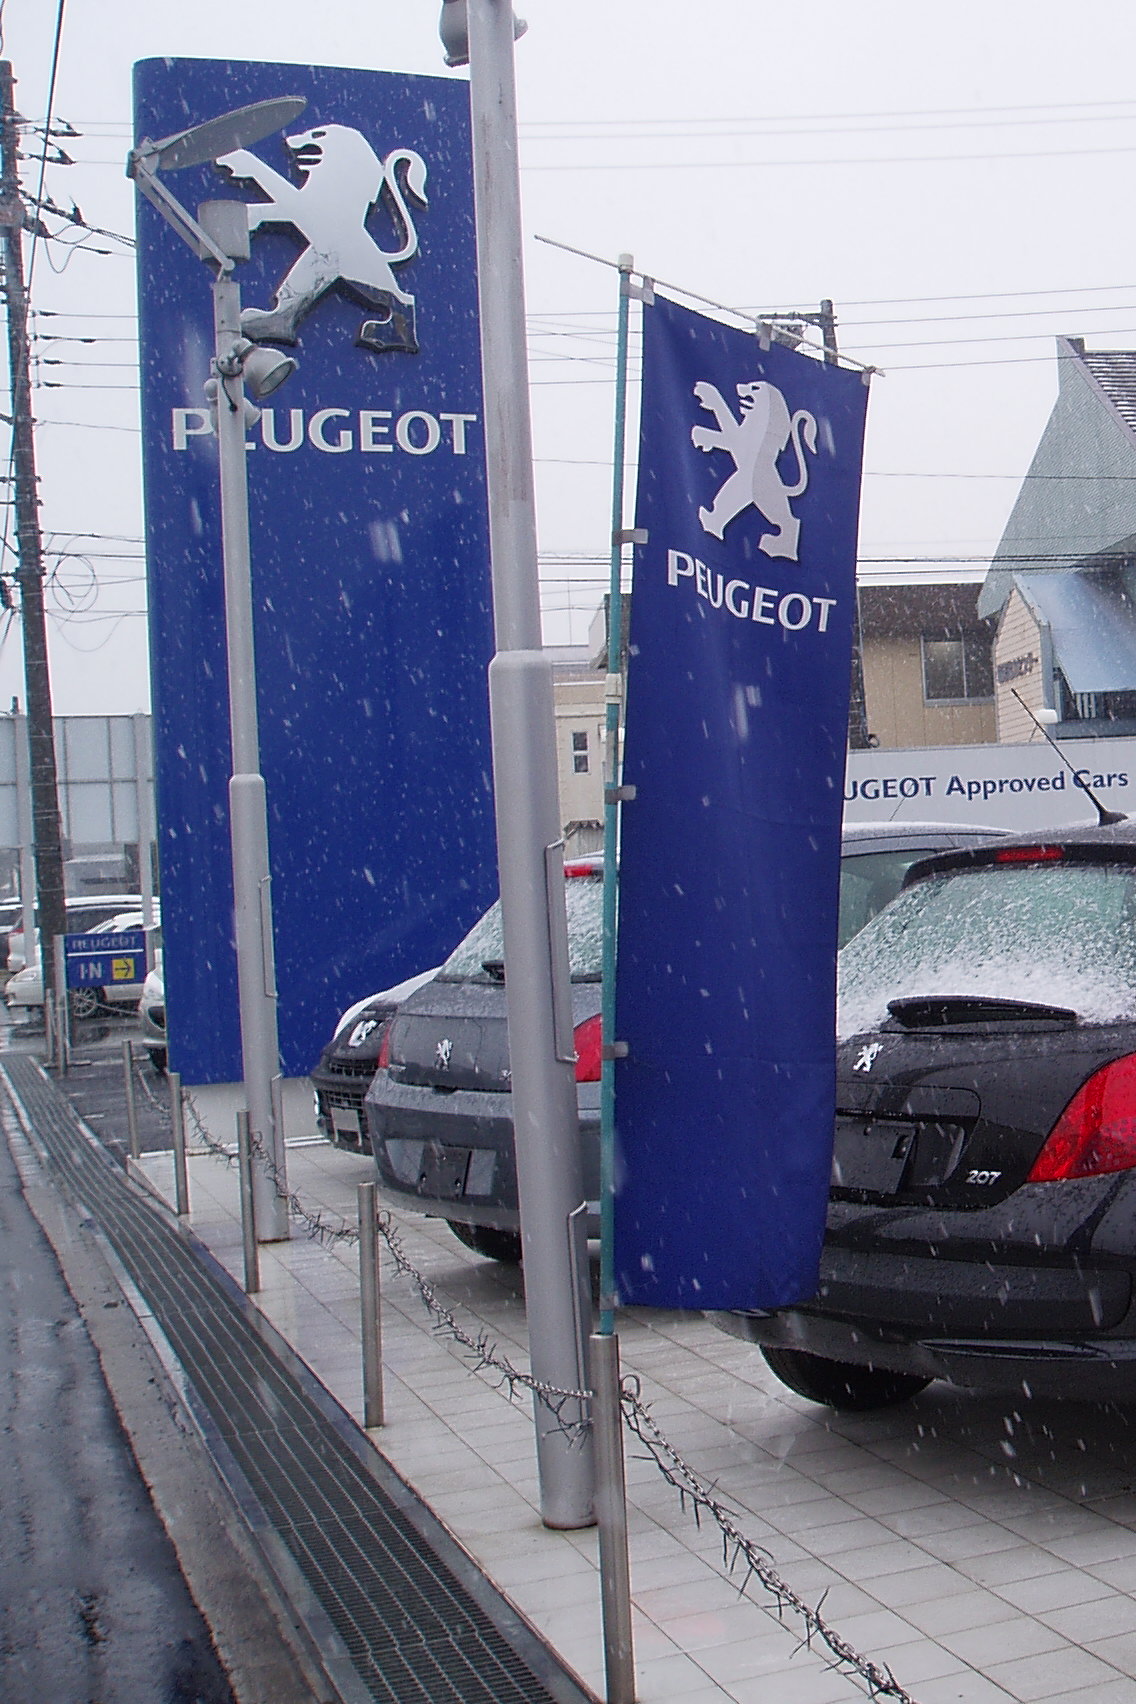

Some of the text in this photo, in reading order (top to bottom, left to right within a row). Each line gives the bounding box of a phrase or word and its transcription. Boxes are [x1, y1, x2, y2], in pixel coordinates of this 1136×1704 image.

[172, 408, 477, 454] PUGEOT
[667, 549, 837, 632] PEUGEOT
[844, 769, 1128, 800] UGEOT Approved Cars
[80, 962, 102, 980] IN
[965, 1169, 1002, 1186] 207
